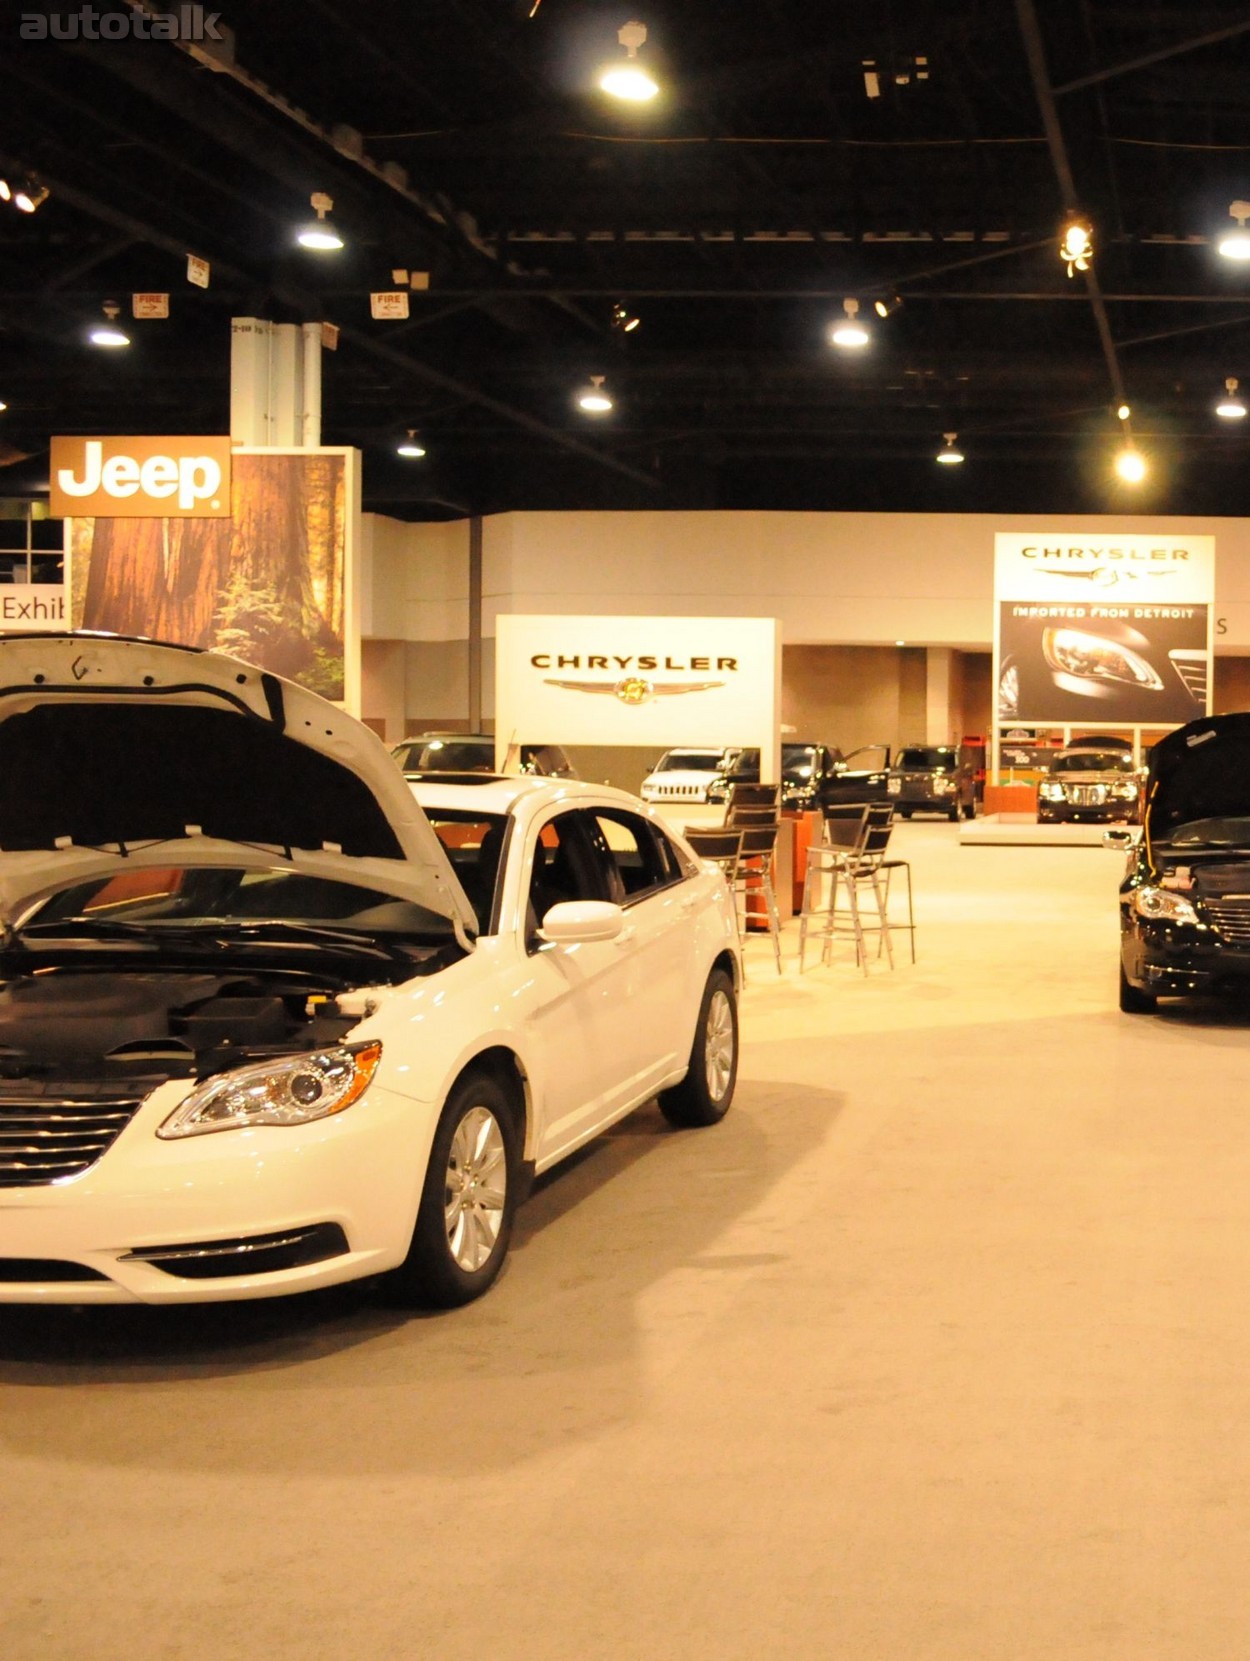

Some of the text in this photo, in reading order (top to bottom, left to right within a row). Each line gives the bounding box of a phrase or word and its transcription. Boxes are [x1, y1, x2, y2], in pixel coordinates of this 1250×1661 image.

[139, 295, 162, 303] FIRE
[377, 294, 401, 303] FIRE
[58, 441, 221, 509] Jeep
[1021, 547, 1189, 560] CHRYSLER
[1013, 605, 1195, 619] IMPORTED FROM DETROIT
[530, 654, 738, 671] CHRYSLER
